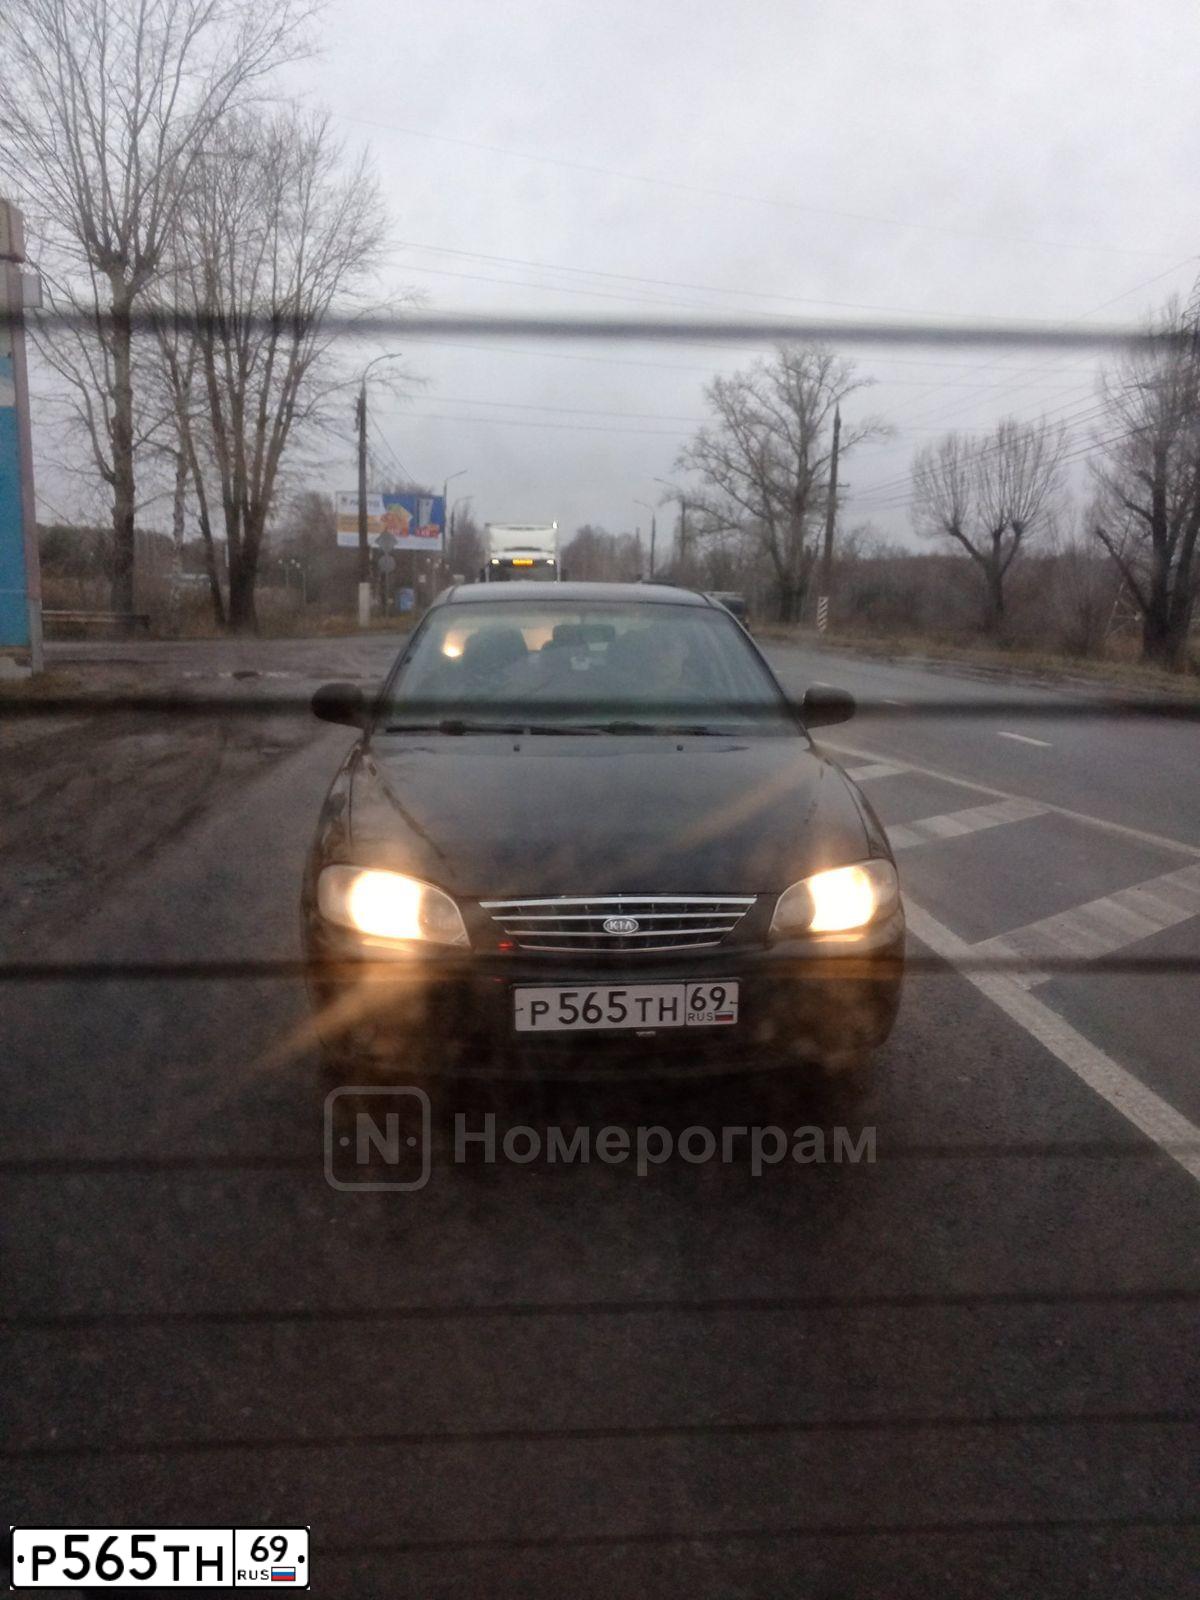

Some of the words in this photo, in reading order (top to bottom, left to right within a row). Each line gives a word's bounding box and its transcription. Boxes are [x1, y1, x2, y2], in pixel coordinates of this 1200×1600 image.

[609, 920, 634, 930] KIA
[530, 991, 678, 1026] Р565ТН
[690, 986, 726, 1011] 69
[687, 1013, 714, 1022] RUS
